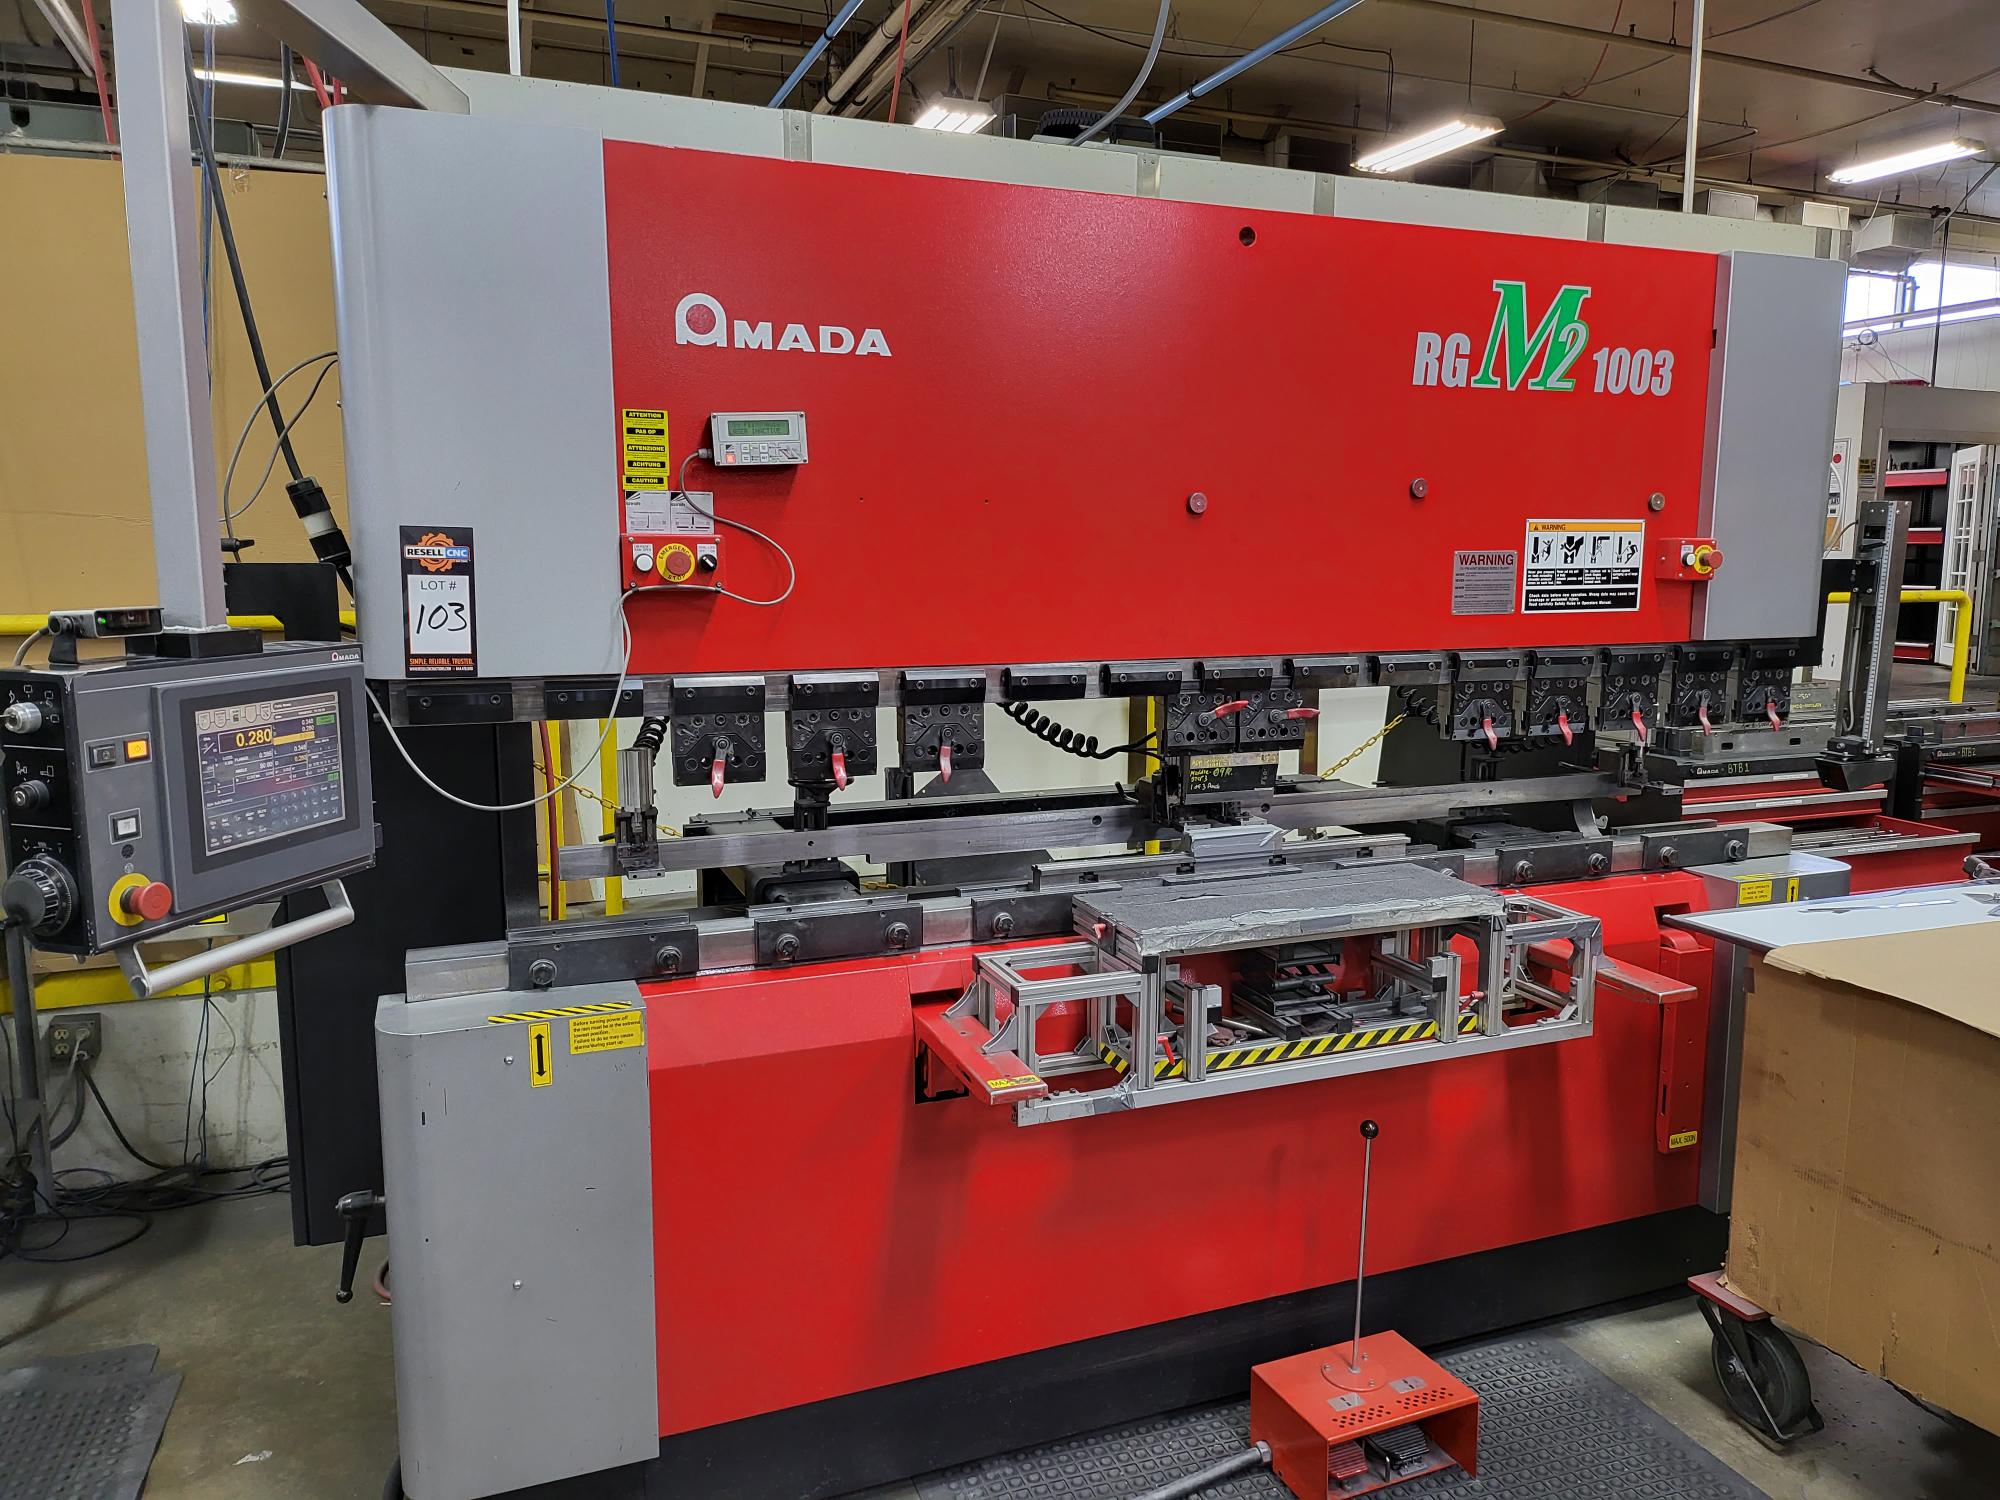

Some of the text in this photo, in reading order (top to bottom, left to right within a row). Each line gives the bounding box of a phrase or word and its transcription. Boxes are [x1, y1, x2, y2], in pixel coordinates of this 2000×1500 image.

[675, 292, 892, 357] AMADA
[1412, 331, 1471, 388] RG
[1592, 346, 1675, 397] 1003
[407, 548, 468, 557] RESELL CNC
[1459, 554, 1514, 566] WARNING
[420, 580, 457, 591] LOT #
[416, 602, 468, 635] 103
[331, 651, 360, 662] AMADA
[235, 728, 272, 748] 0.280
